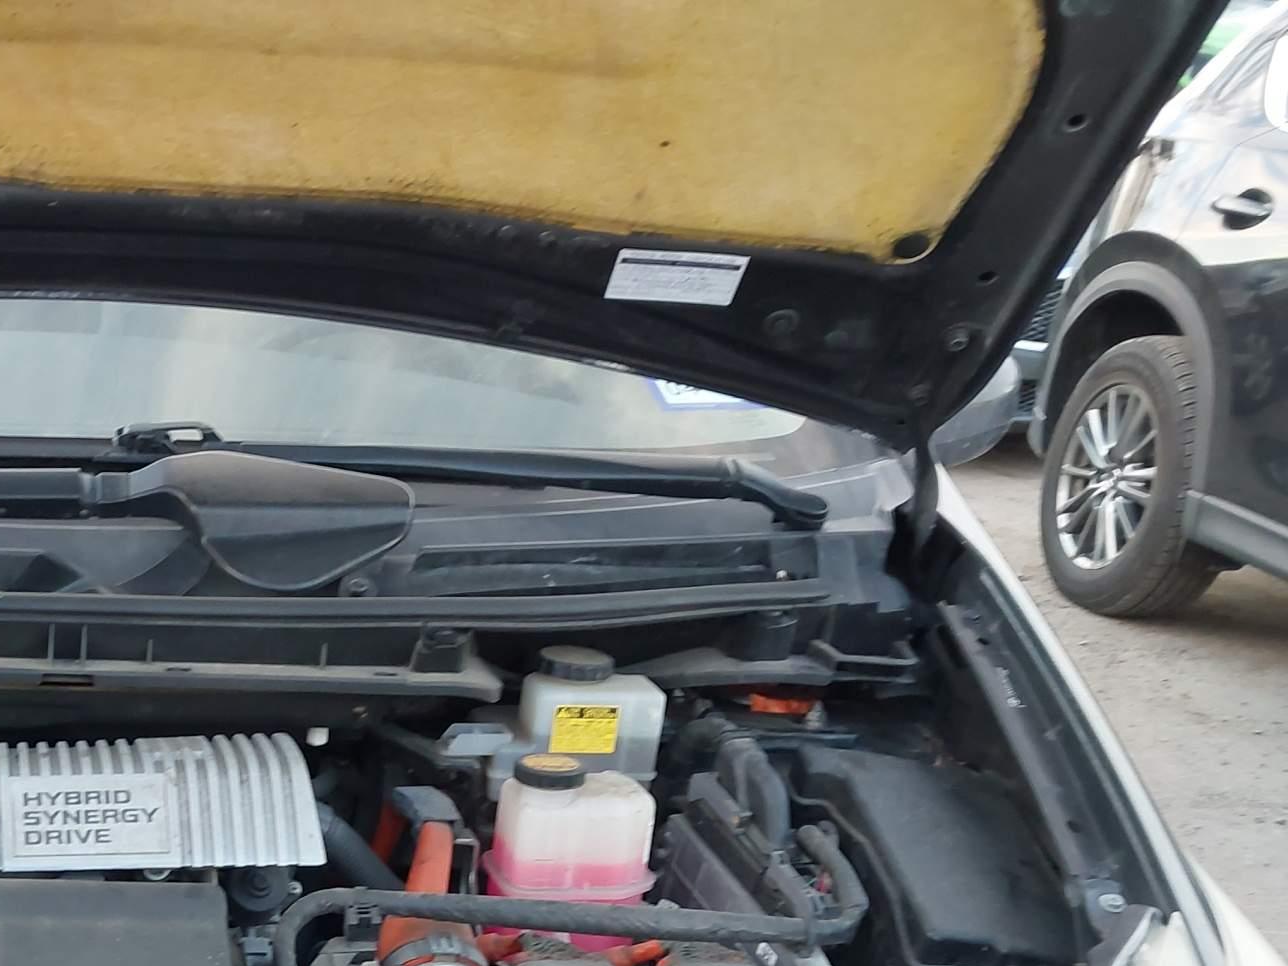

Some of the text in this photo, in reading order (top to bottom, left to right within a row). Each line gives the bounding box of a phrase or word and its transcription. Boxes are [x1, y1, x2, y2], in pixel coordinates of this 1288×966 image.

[23, 790, 131, 806] HYBRID
[23, 807, 160, 826] SYNERGY
[24, 828, 113, 845] DRIVE
